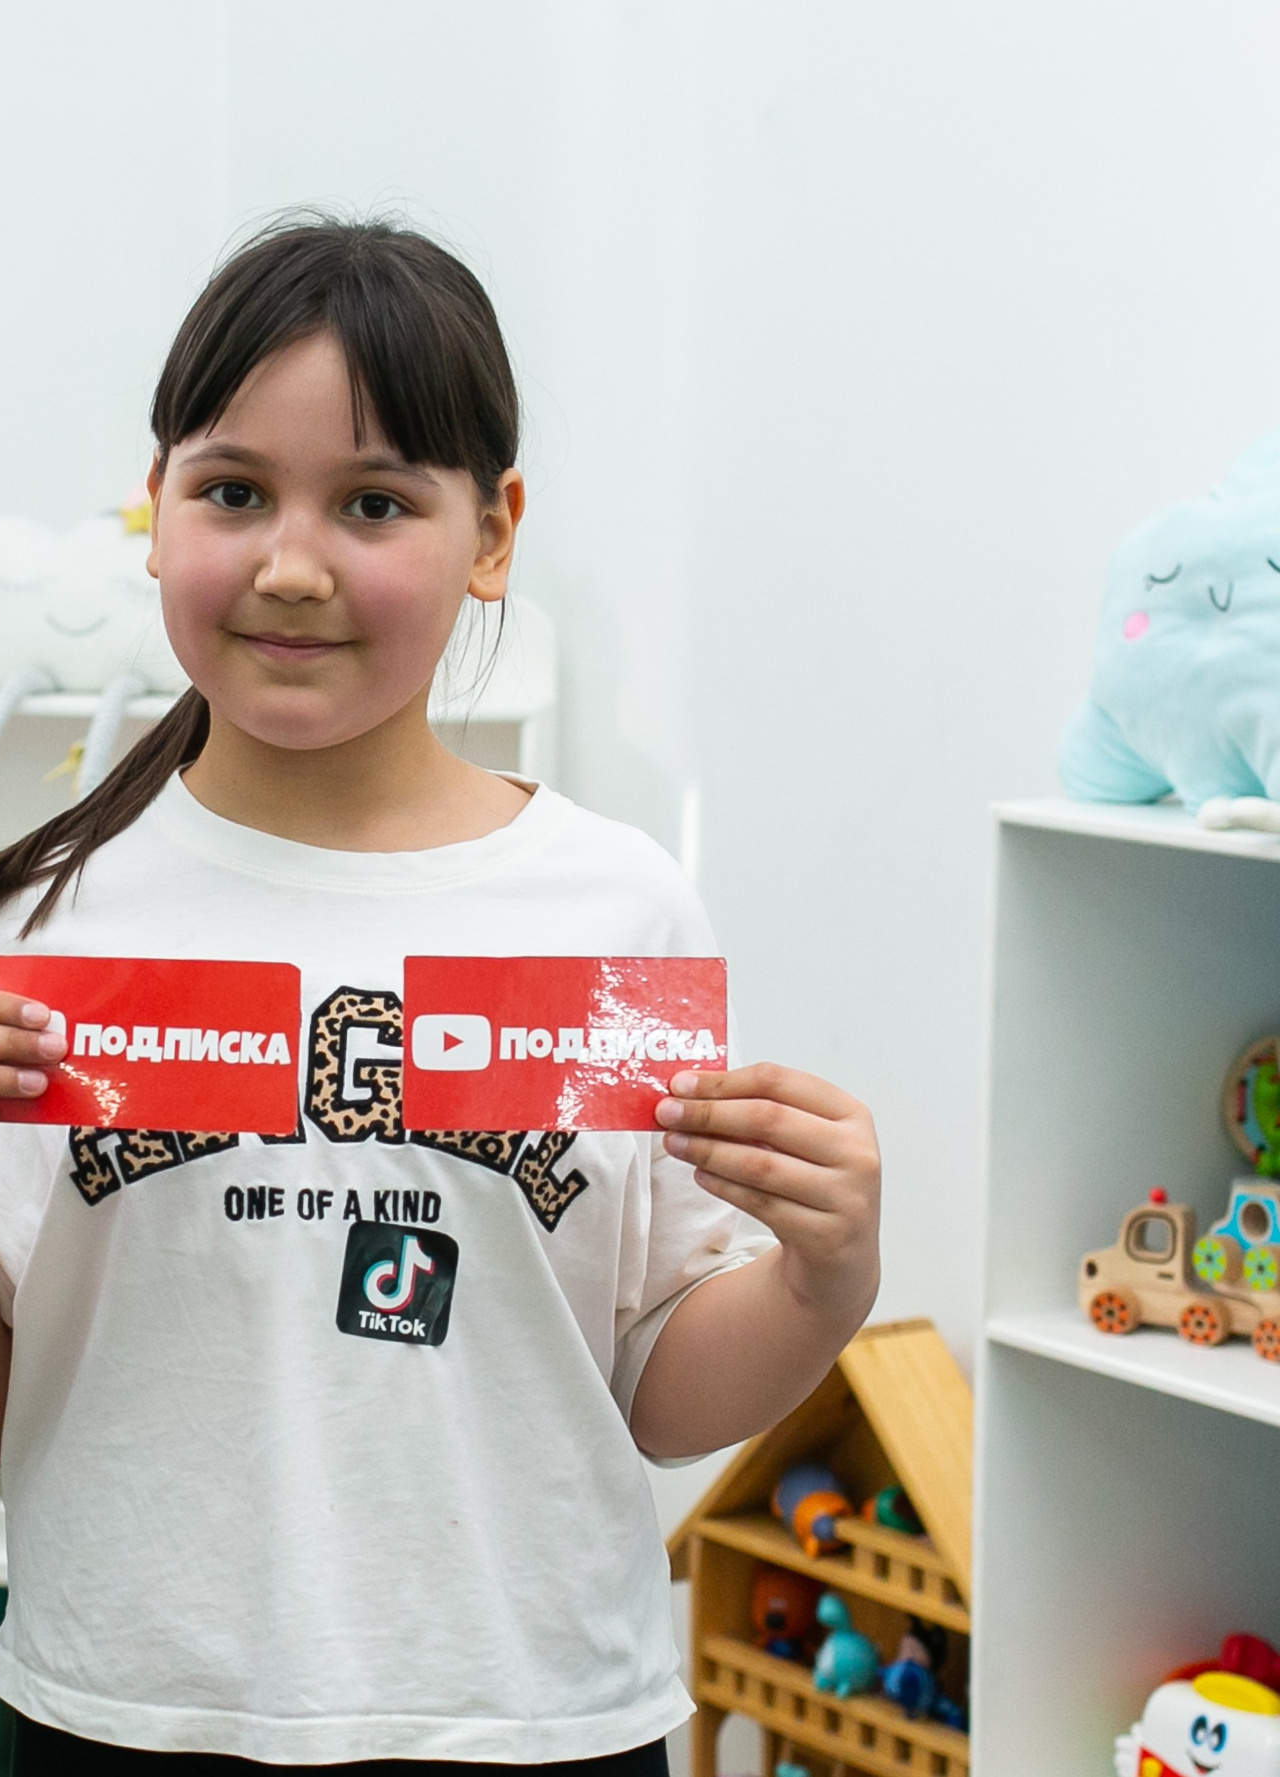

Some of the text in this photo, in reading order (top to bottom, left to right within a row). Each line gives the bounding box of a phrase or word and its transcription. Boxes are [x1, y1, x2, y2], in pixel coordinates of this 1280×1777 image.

[73, 1022, 291, 1065] ПОДПИСКА
[498, 1027, 718, 1064] ПОДПИСКА
[224, 1185, 442, 1223] ONE OF A KIND
[358, 1310, 426, 1338] TikTok
